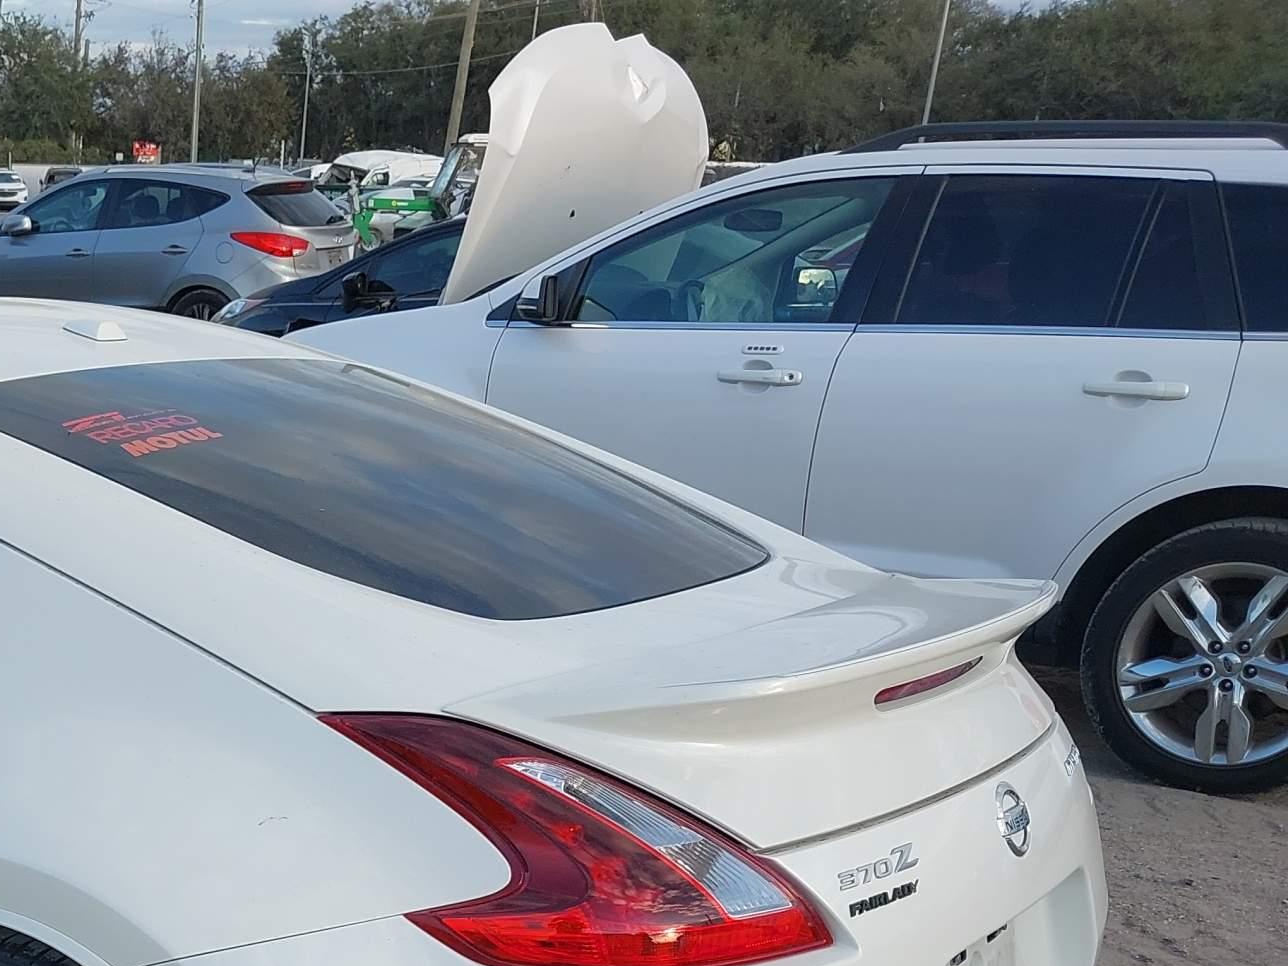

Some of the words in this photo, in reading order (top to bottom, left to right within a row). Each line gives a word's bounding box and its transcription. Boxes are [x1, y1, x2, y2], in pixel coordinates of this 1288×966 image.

[120, 421, 224, 458] MOTUL
[837, 842, 919, 891] 370Z
[848, 878, 919, 918] FAIRLADY
